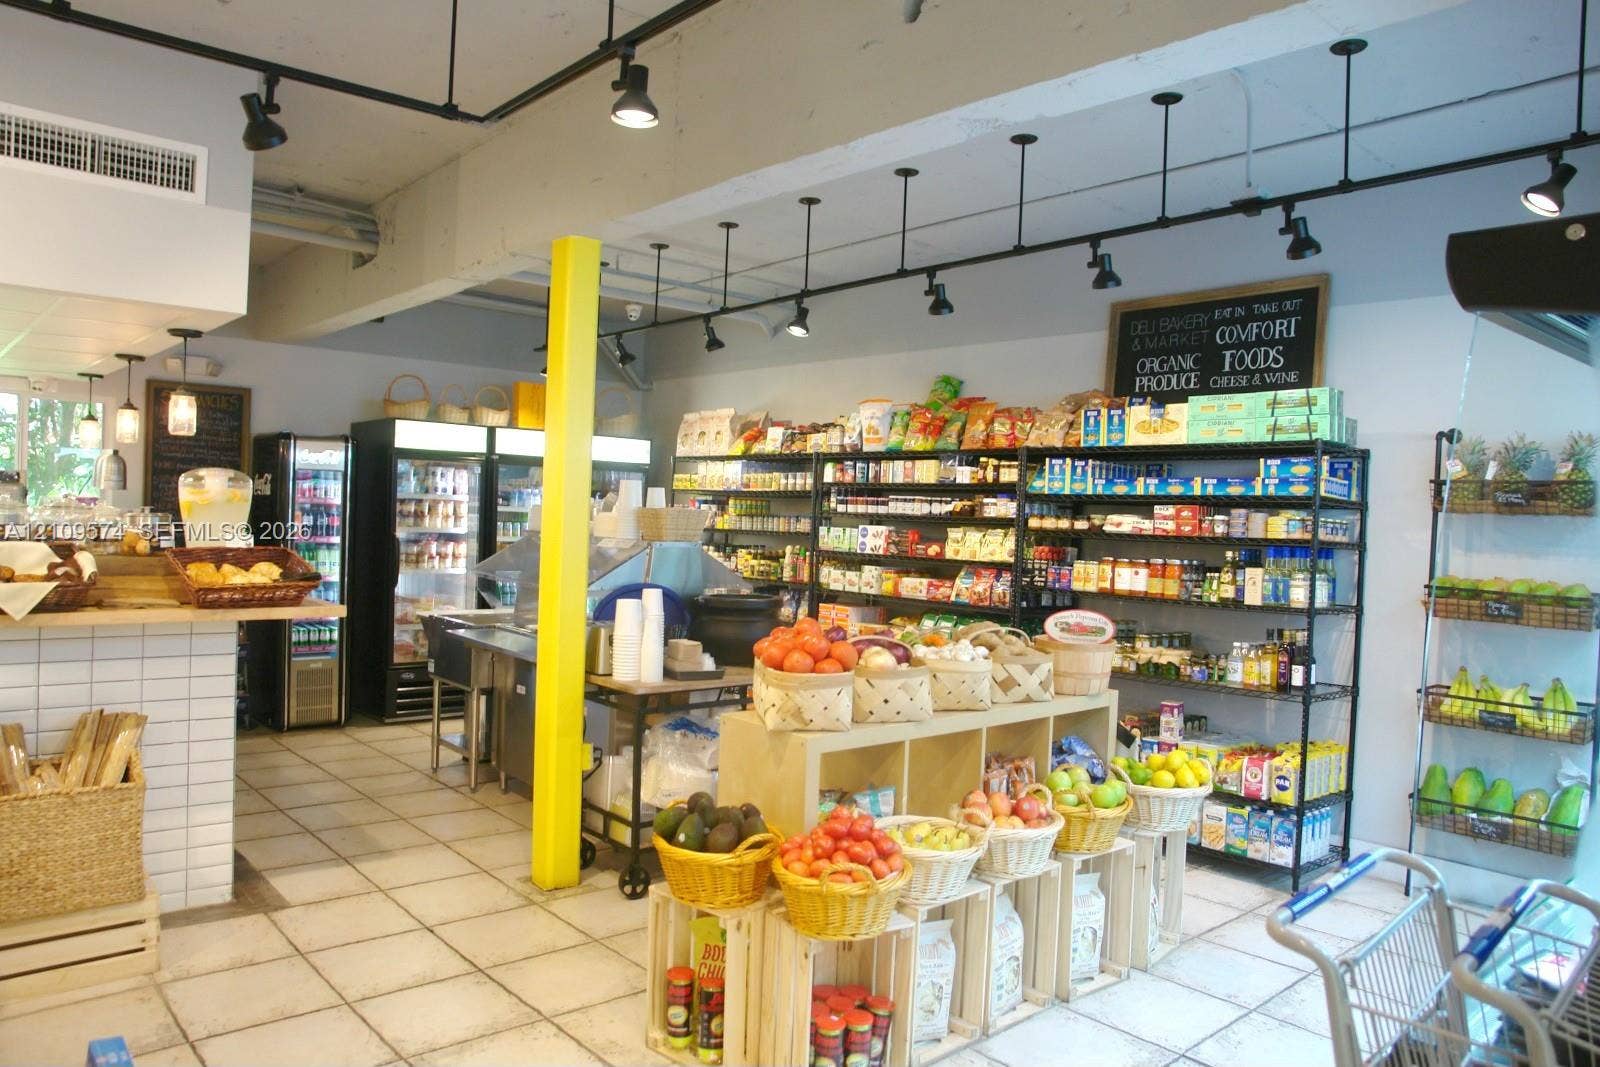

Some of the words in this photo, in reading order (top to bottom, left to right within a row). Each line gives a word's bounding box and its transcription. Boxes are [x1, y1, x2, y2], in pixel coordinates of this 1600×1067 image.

[1214, 307, 1233, 319] EAT
[1235, 305, 1246, 317] IN
[1253, 302, 1279, 314] TAKE
[1282, 299, 1303, 311] OUT
[1130, 320, 1156, 335] DELI
[1160, 312, 1211, 332] BAKERY
[1215, 317, 1302, 344] COMFORT
[1132, 338, 1141, 351] &
[1145, 330, 1210, 350] MARKET
[1136, 353, 1202, 374] ORGANIC
[1222, 346, 1284, 371] FOODS
[1135, 372, 1201, 392] PRODUCE
[1209, 374, 1250, 388] CHEESE
[1251, 373, 1262, 385] &
[1264, 371, 1300, 384] WINE
